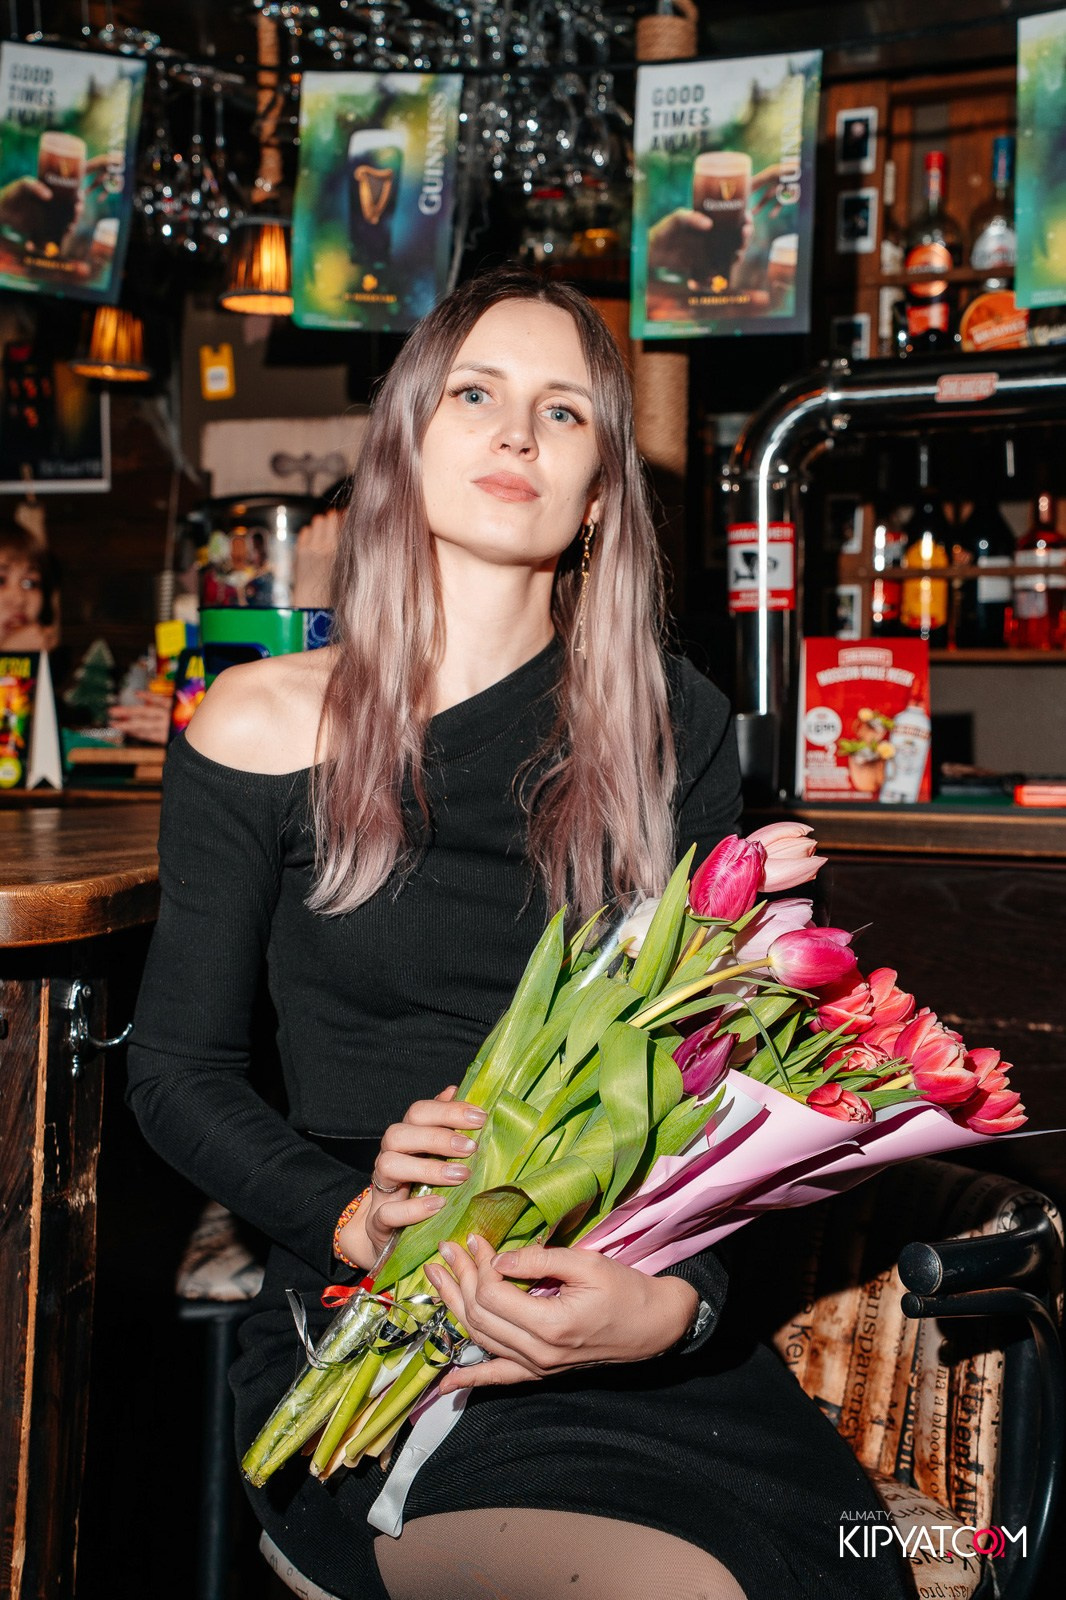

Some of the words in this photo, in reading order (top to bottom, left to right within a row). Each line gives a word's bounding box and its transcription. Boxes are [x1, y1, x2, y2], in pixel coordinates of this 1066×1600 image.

[652, 84, 705, 107] GOOD
[653, 107, 712, 128] TIMES
[417, 92, 448, 216] GUINNESS
[926, 1411, 947, 1475] bloody
